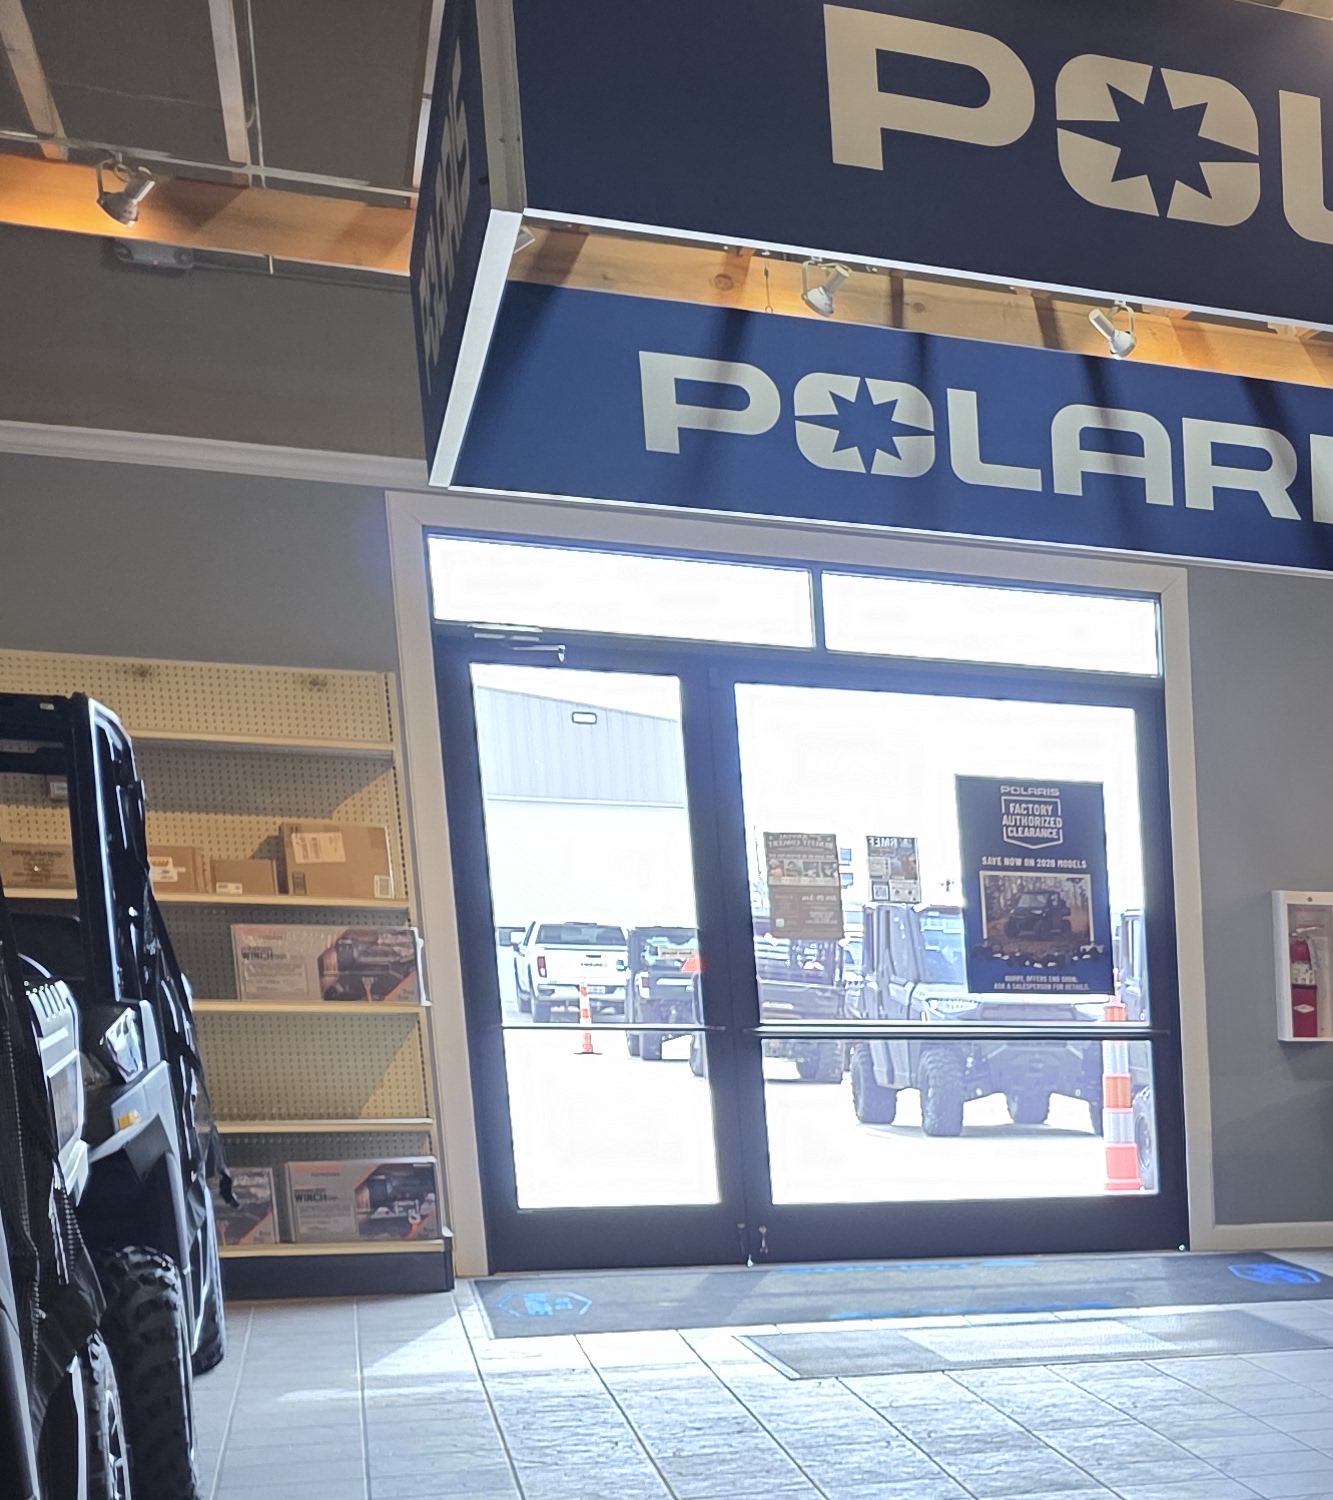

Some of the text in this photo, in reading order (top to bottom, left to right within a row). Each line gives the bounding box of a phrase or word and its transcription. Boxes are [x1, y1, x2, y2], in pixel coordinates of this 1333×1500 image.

[1000, 785, 1060, 797] POLARIS
[1009, 802, 1053, 815] FACTORY
[1002, 814, 1063, 829] AUTHORIZED
[1007, 827, 1059, 840] CLEARANCE
[981, 856, 1003, 866] SAVE
[1004, 857, 1023, 867] NOW
[1024, 858, 1035, 868] ON
[1057, 860, 1088, 870] MODELS
[295, 1193, 327, 1203] WINCH
